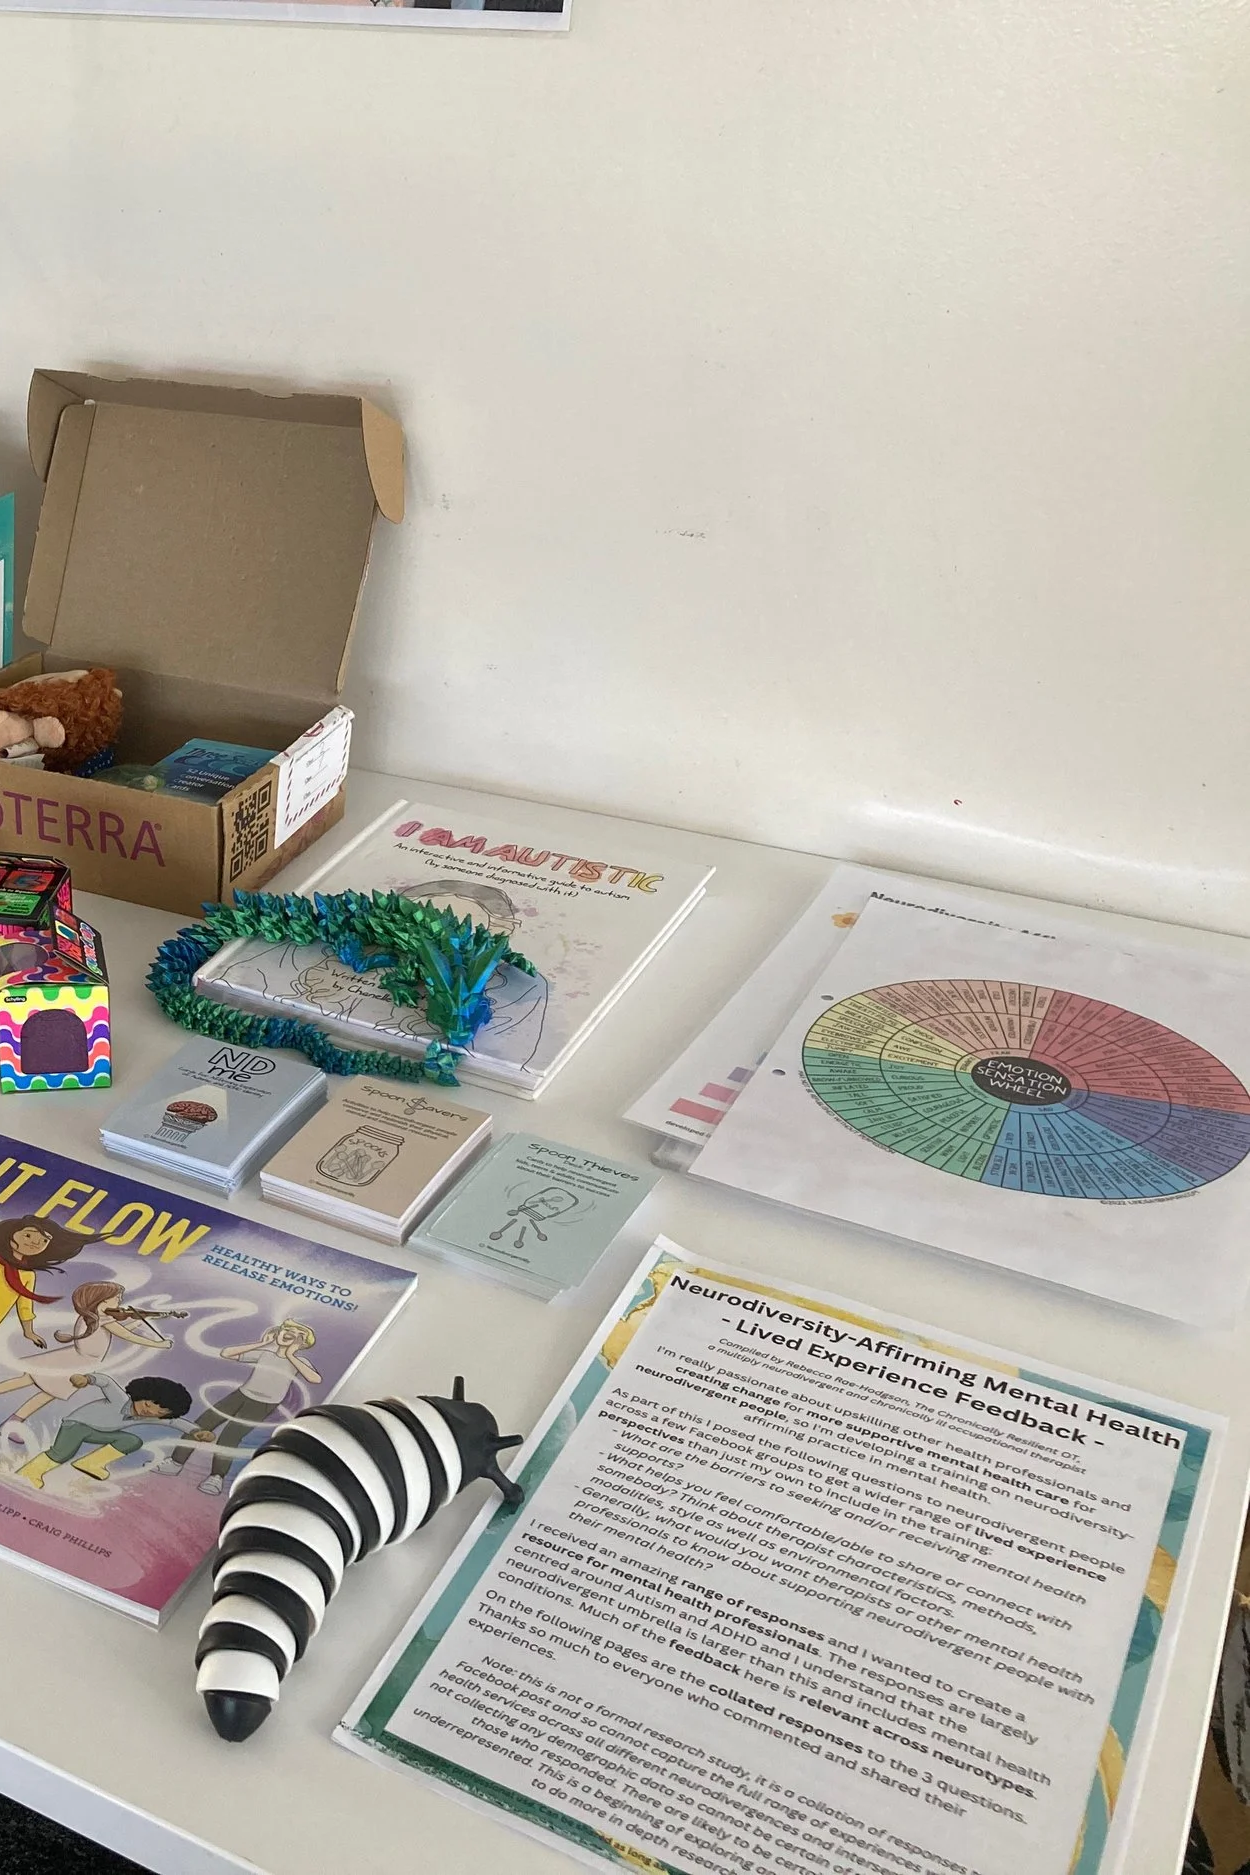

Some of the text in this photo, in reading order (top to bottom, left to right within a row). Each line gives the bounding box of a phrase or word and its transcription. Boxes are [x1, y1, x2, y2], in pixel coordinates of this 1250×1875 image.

[198, 770, 230, 781] Unique
[393, 843, 632, 899] An interactive and informative guide to autism
[402, 822, 664, 893] I AM AUTISTIC
[423, 859, 580, 897] (by someone diagnosed with it)
[331, 969, 376, 987] Written
[332, 981, 344, 991] by
[207, 1065, 252, 1083] me
[208, 1046, 276, 1075] ND
[887, 1053, 940, 1066] EXCITEMENT
[987, 1060, 1063, 1085] EMOTION
[361, 1084, 406, 1102] Spoon
[976, 1066, 1067, 1096] SENSATION
[989, 1078, 1046, 1100] WHEEL
[665, 1120, 703, 1137] developed
[528, 1143, 640, 1182] Spoon Thieves
[36, 1176, 210, 1264] FLOW
[202, 1254, 359, 1313] RELEASE EMOTIONS!
[211, 1244, 352, 1296] HEALTHY WAYS TO
[669, 1275, 1186, 1449] Neurodiversity-Affirming Mental Health
[735, 1319, 1092, 1445] Lived Experience Feedback
[674, 1364, 1098, 1513] creating change for more supportive mental health care for
[28, 1518, 62, 1537] CRAIG
[63, 1533, 112, 1559] PHILLIPS
